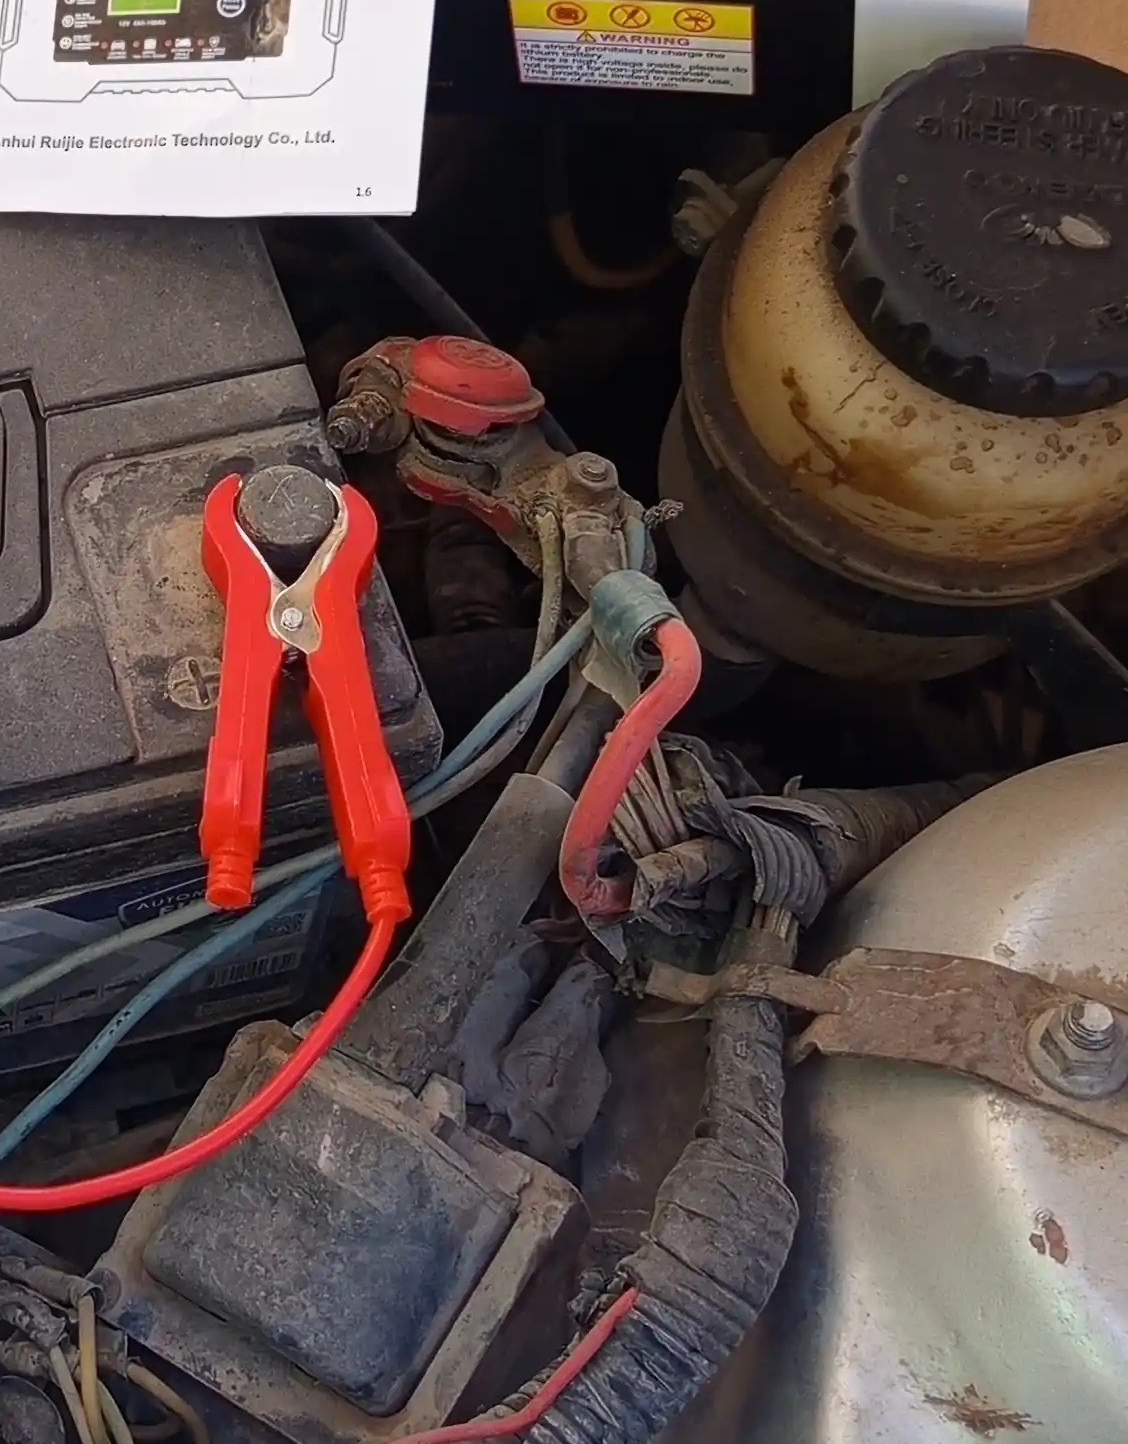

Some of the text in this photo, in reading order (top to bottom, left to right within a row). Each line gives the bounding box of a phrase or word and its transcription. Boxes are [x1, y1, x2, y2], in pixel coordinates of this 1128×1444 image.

[599, 33, 691, 47] WARNING
[543, 43, 582, 53] strictly
[661, 49, 704, 58] charge
[40, 134, 85, 152] Ruijie
[88, 133, 168, 150] Electronic
[171, 131, 263, 150] Technology
[267, 131, 300, 147] Co.,
[304, 130, 336, 145] Ltd.
[355, 186, 373, 199] 1.6
[136, 889, 206, 912] AUTOM
